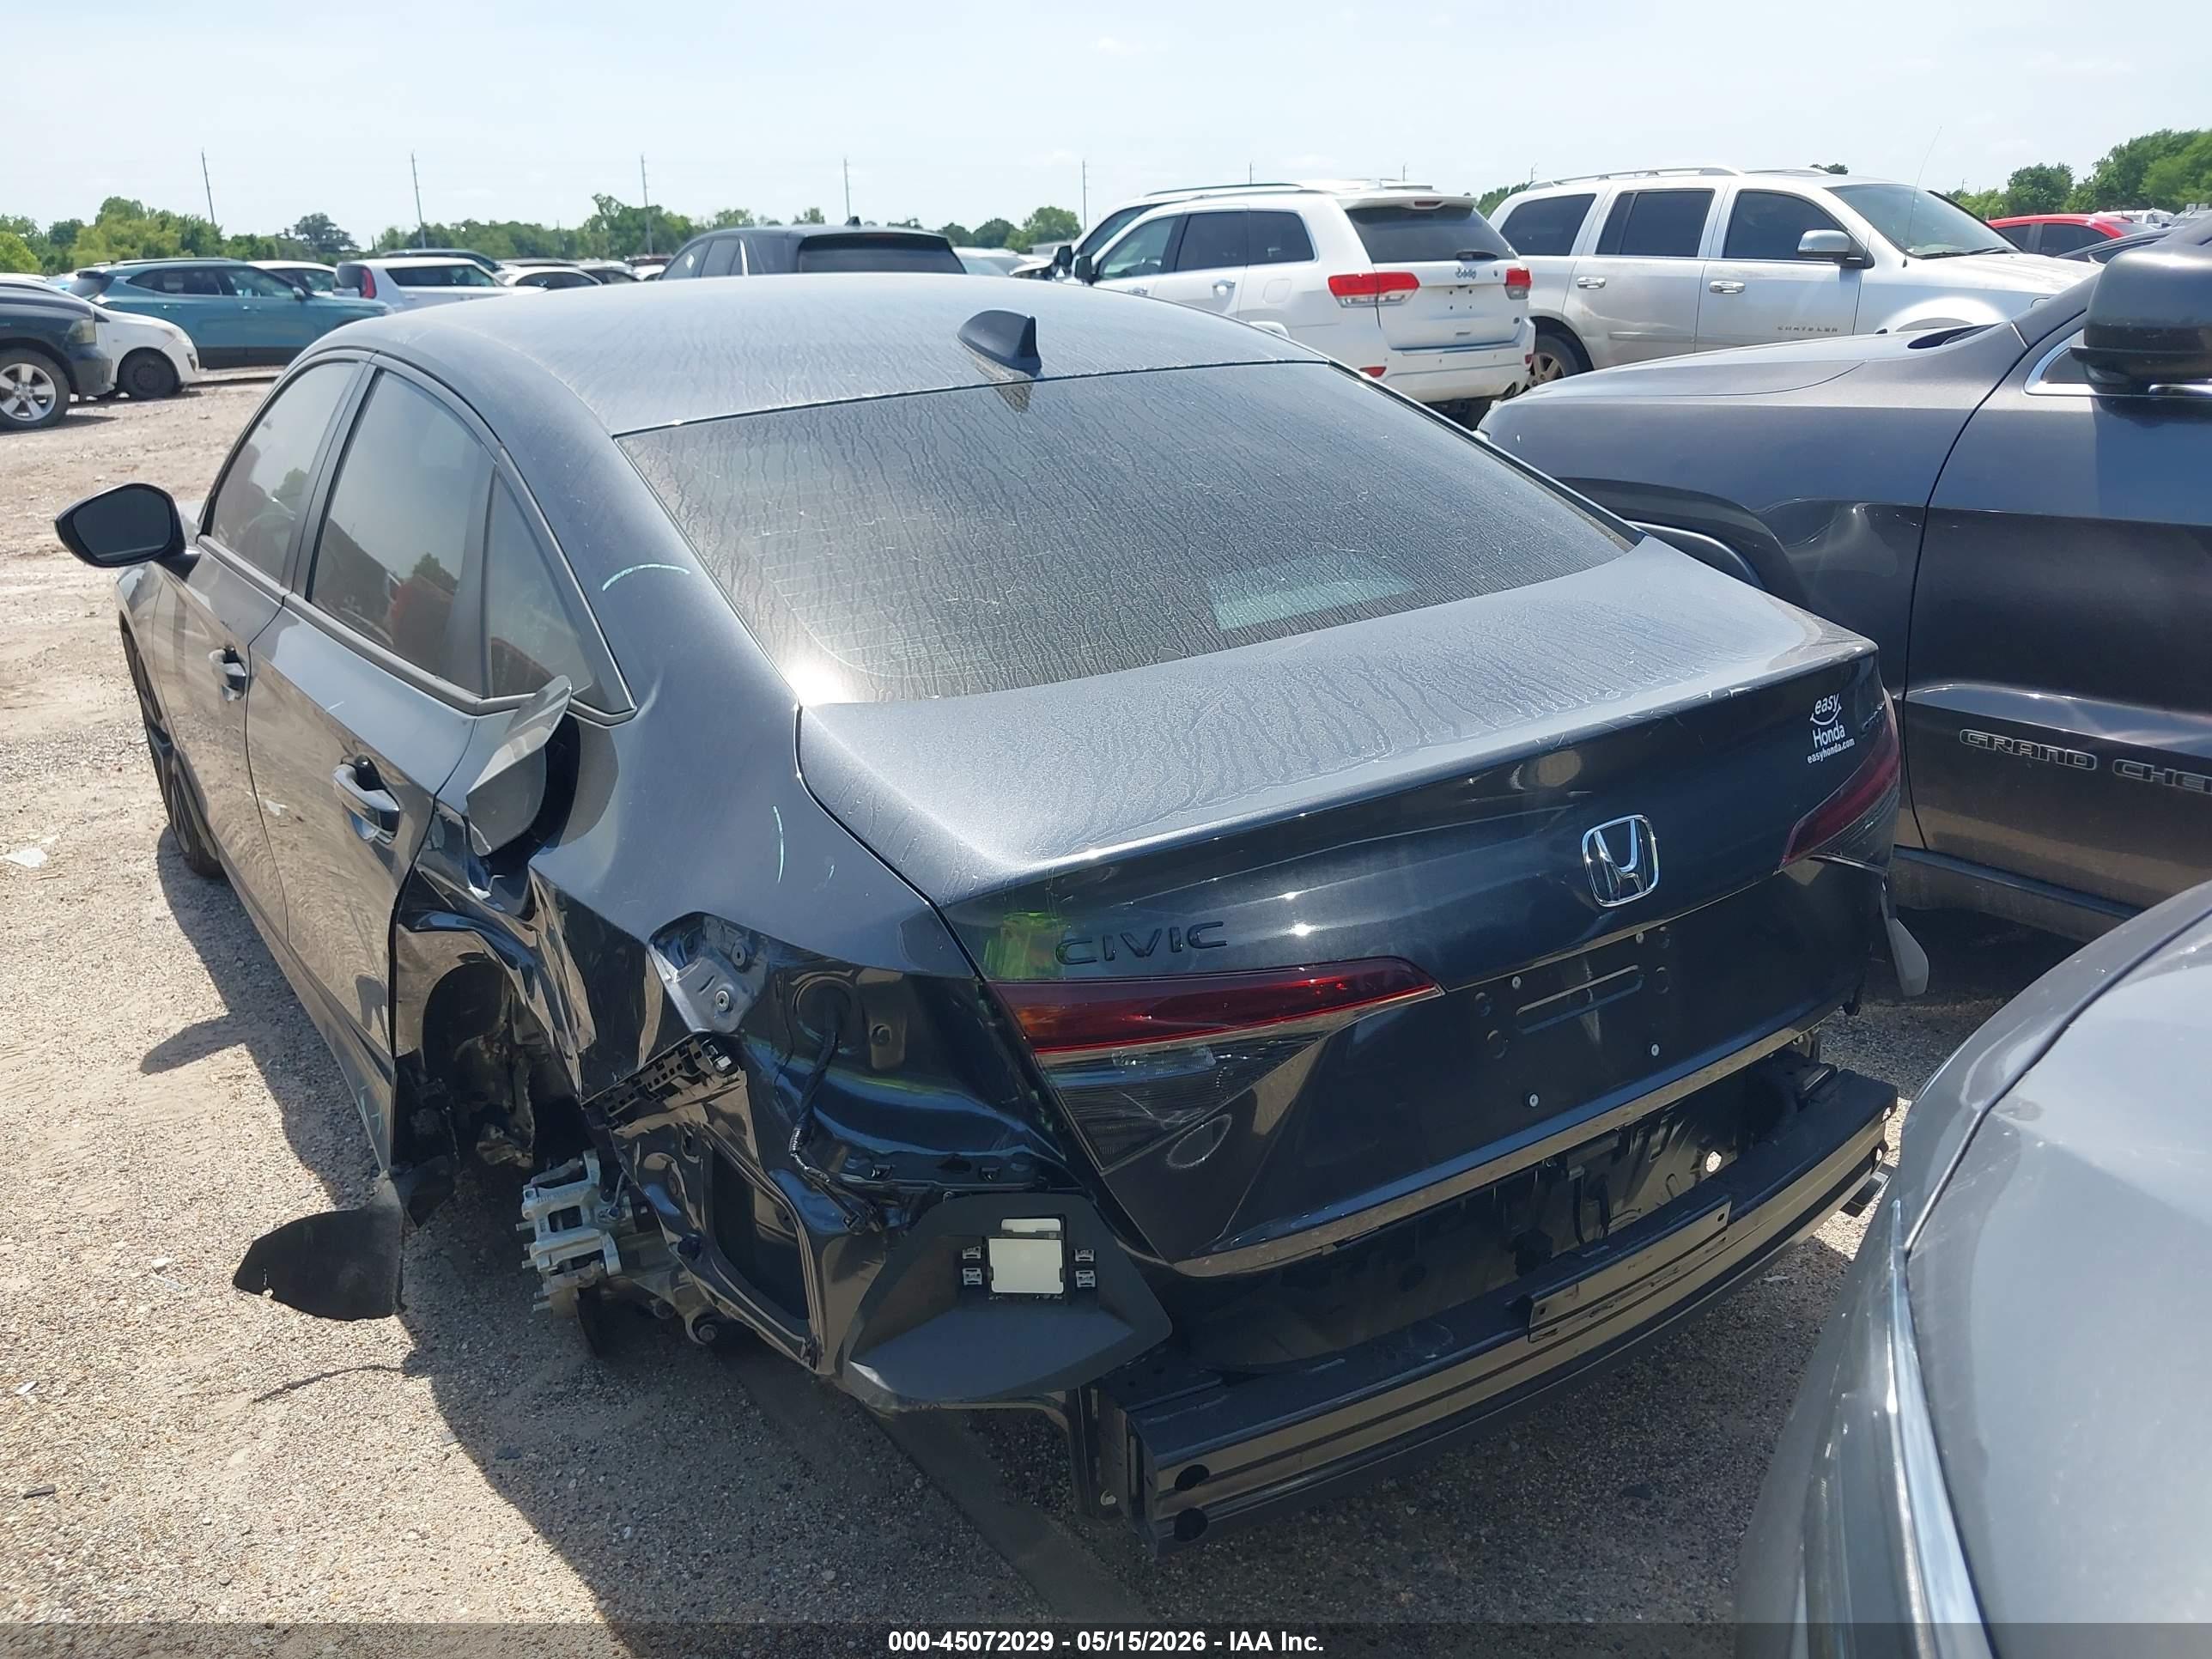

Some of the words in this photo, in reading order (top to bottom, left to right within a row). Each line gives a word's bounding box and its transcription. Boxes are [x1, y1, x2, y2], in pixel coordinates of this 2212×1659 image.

[1814, 693, 1839, 715] easy
[1812, 720, 1845, 749] Honda
[1807, 738, 1855, 764] easyhonda.com
[1959, 728, 2098, 771] GRAND
[2112, 758, 2212, 795] CHE
[1054, 921, 1228, 965] CIVIC
